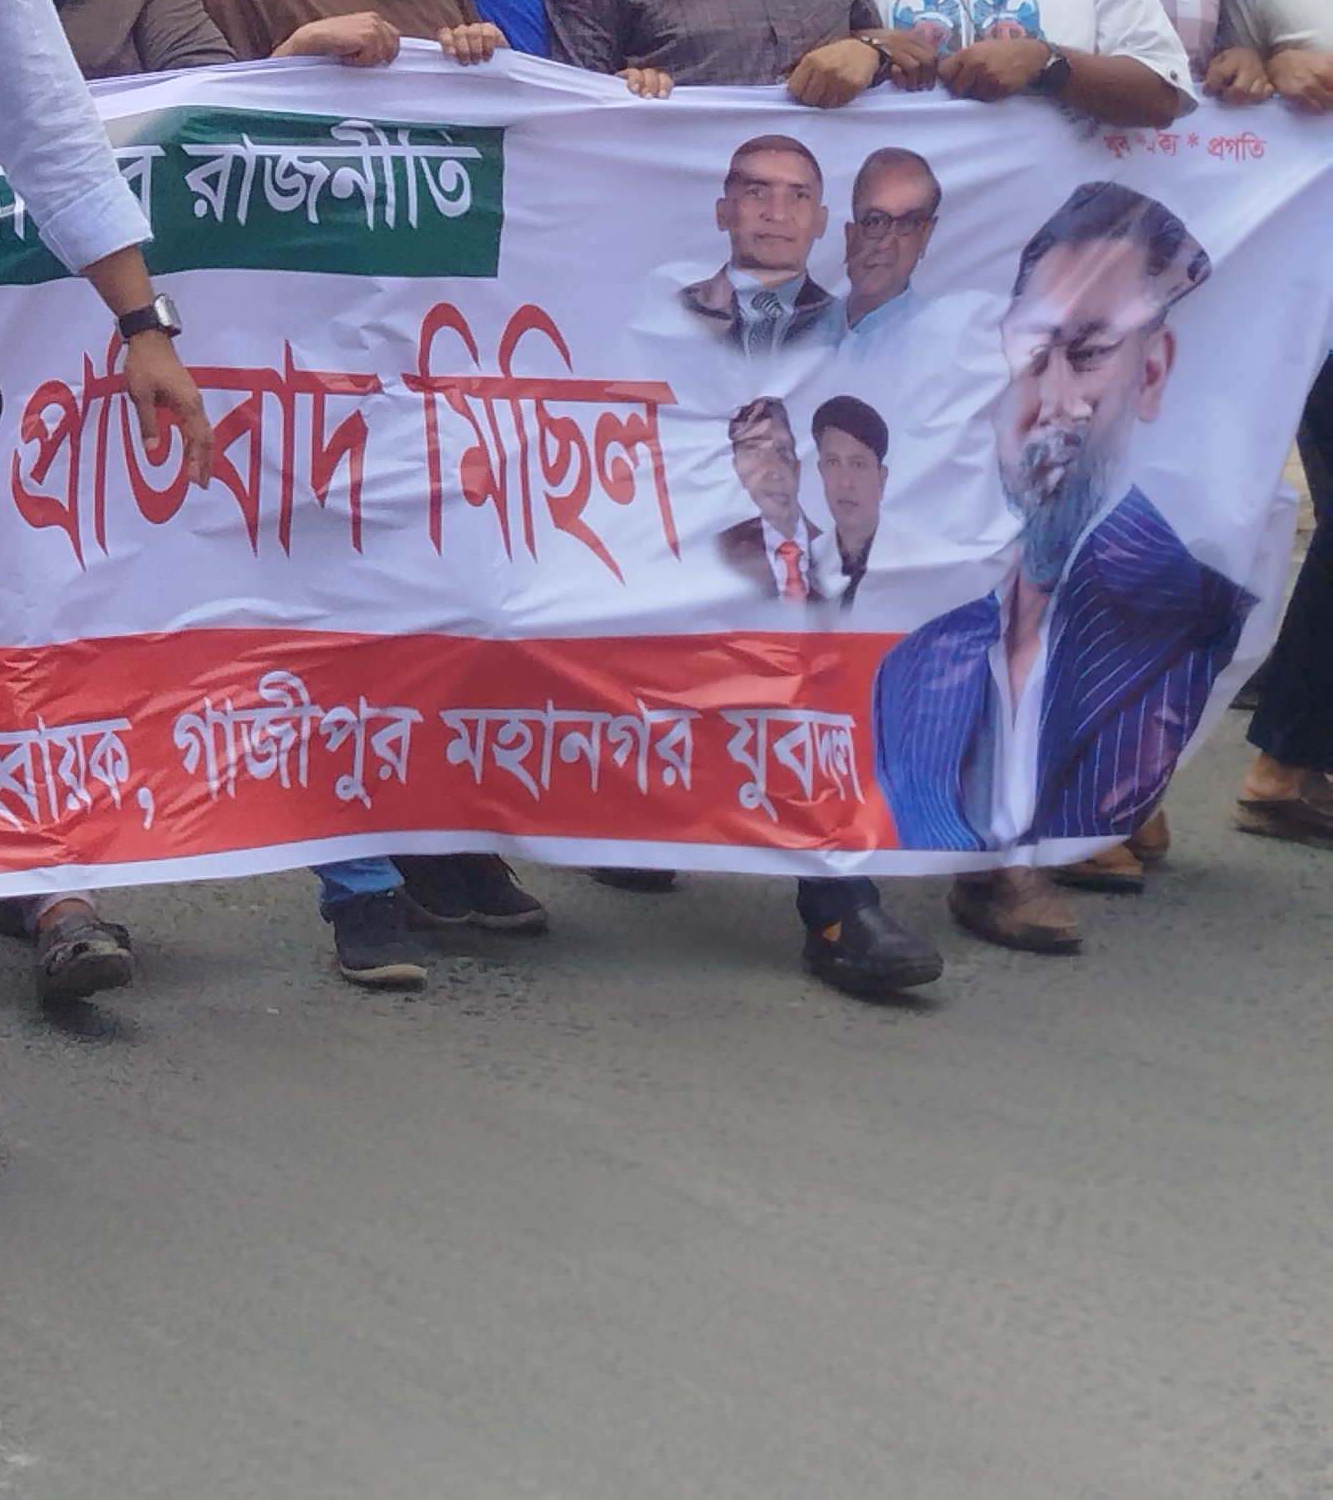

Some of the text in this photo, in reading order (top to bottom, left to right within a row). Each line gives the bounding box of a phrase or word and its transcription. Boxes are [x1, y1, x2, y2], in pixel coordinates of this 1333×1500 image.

[182, 120, 482, 230] রাজনীতি
[1207, 131, 1267, 162] প্রগতি
[11, 330, 382, 572] প্রতিবাদ
[402, 302, 680, 585] মিছিল
[171, 669, 422, 808] গাজীপুর
[443, 697, 701, 798] মহানগর
